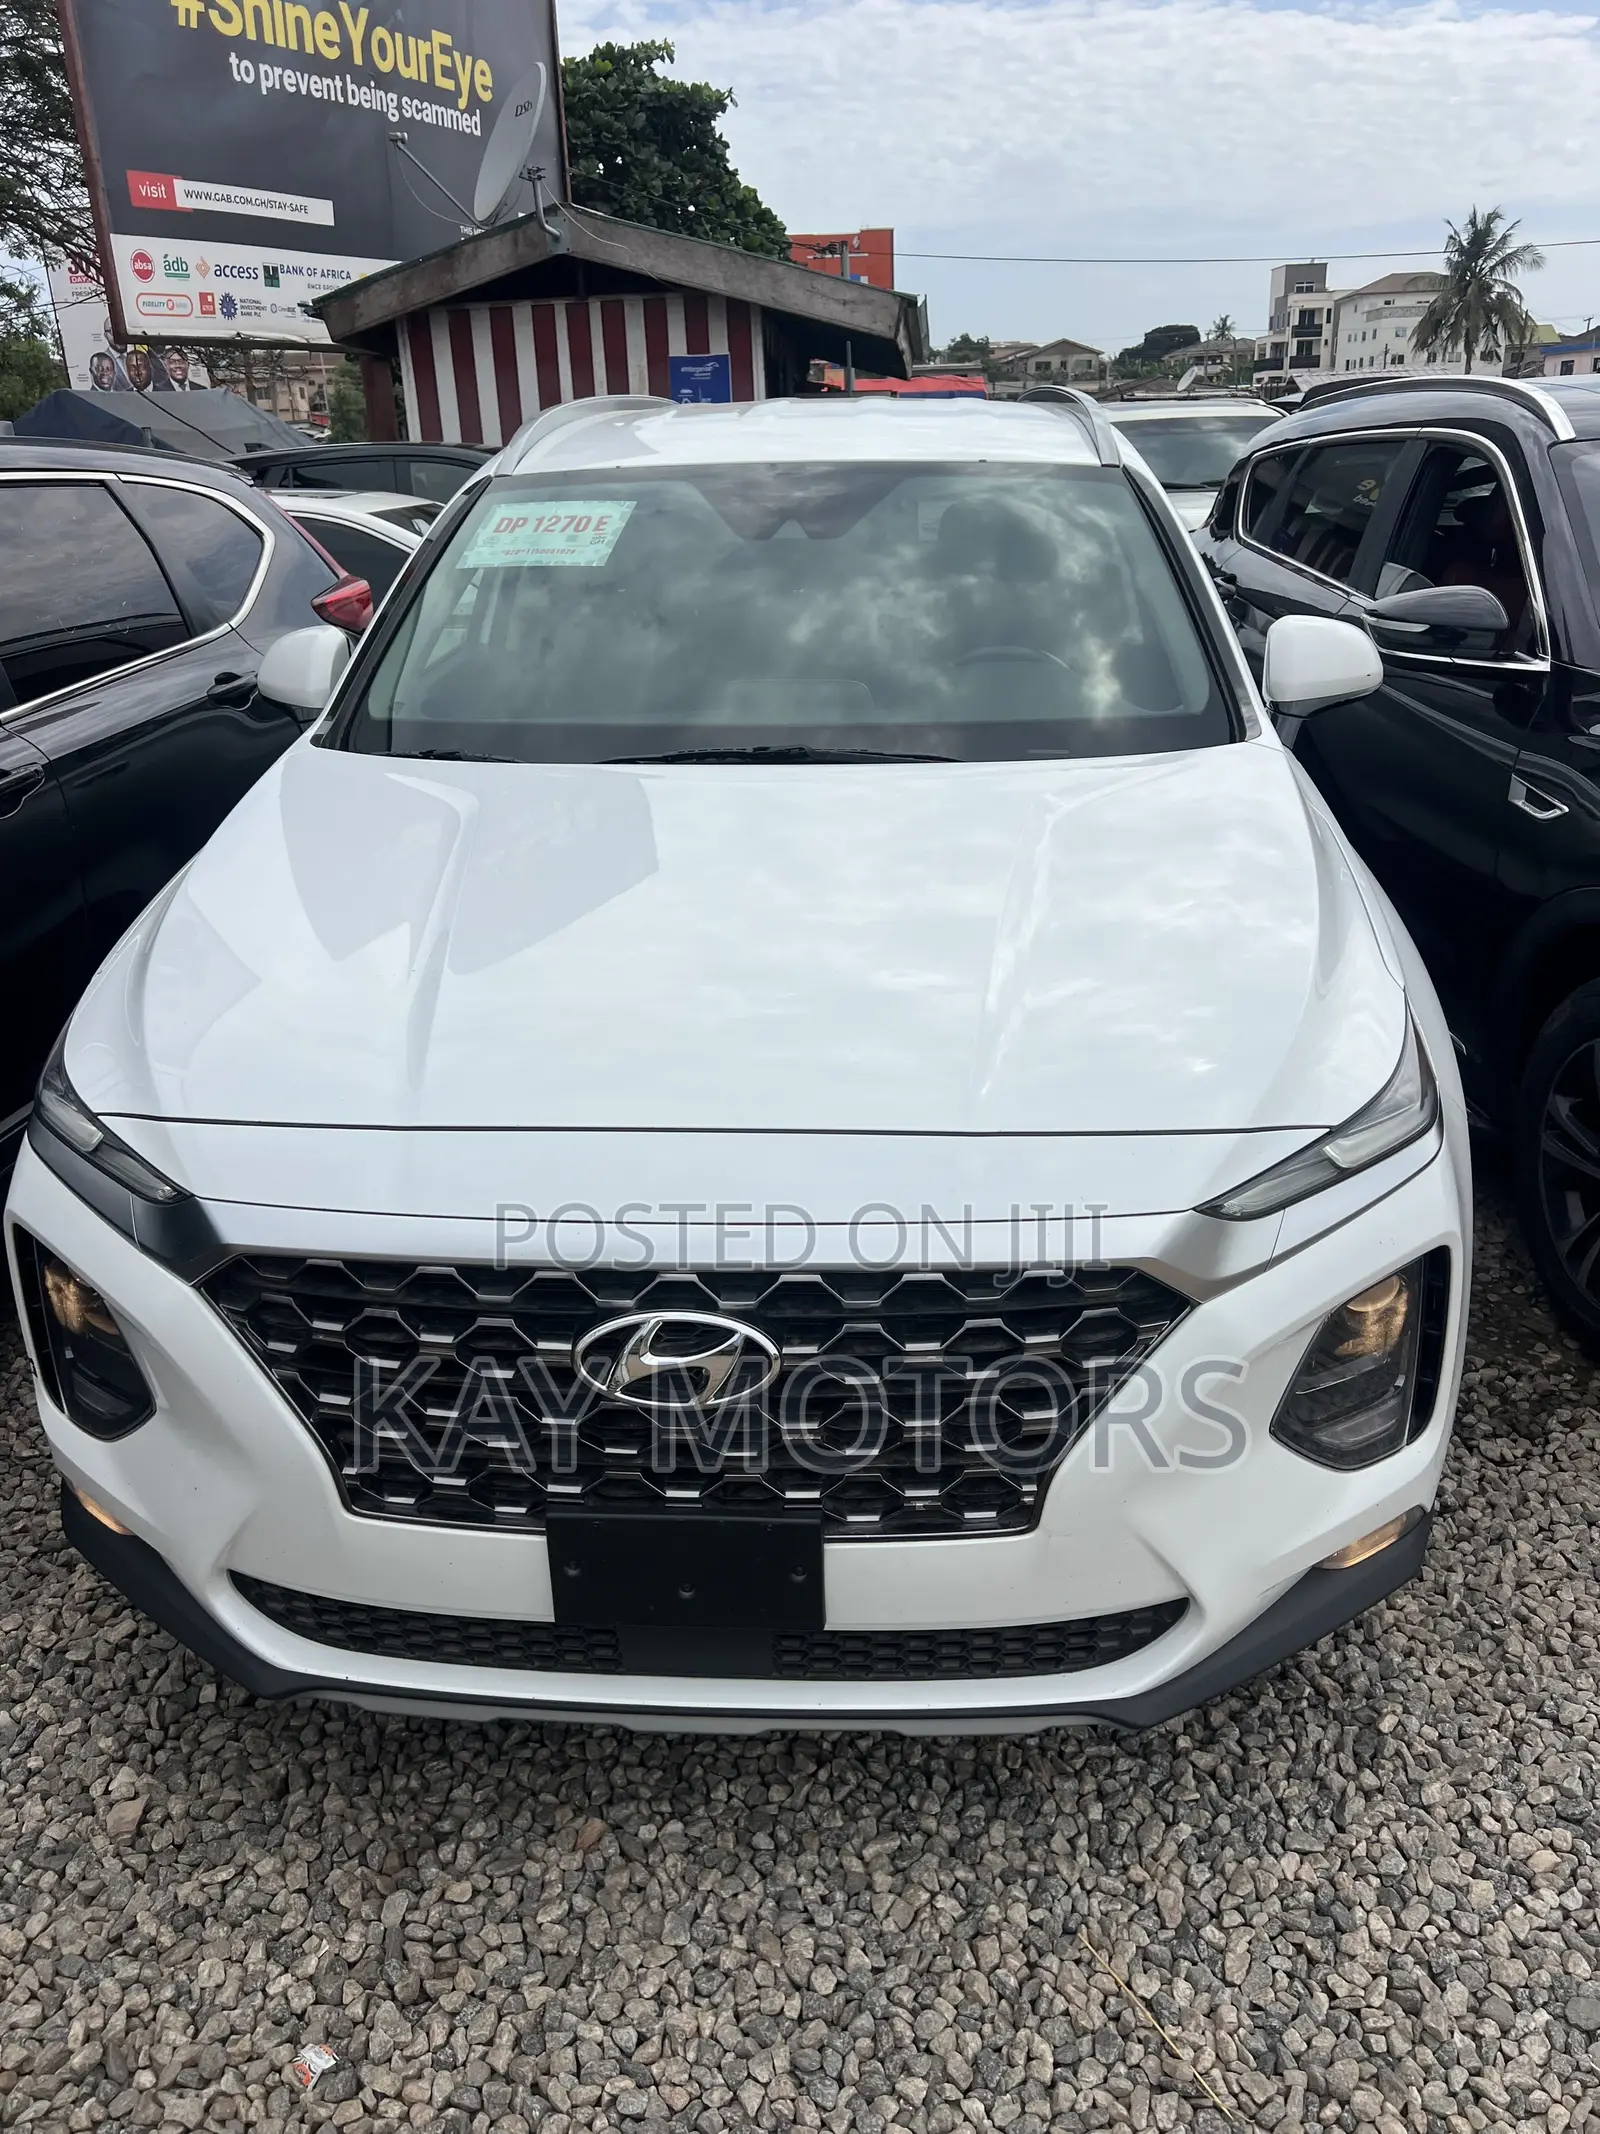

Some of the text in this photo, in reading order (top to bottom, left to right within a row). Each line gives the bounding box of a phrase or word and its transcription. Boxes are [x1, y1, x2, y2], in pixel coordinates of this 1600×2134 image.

[229, 52, 482, 137] to prevent being scammed
[139, 181, 167, 198] visit
[184, 188, 309, 214] WWW.GAB.COM.GH/STAY-SAFE
[134, 259, 152, 270] absa
[214, 264, 259, 280] access
[279, 264, 352, 280] BANK OF AFRICA
[493, 515, 612, 533] DP 1270 E
